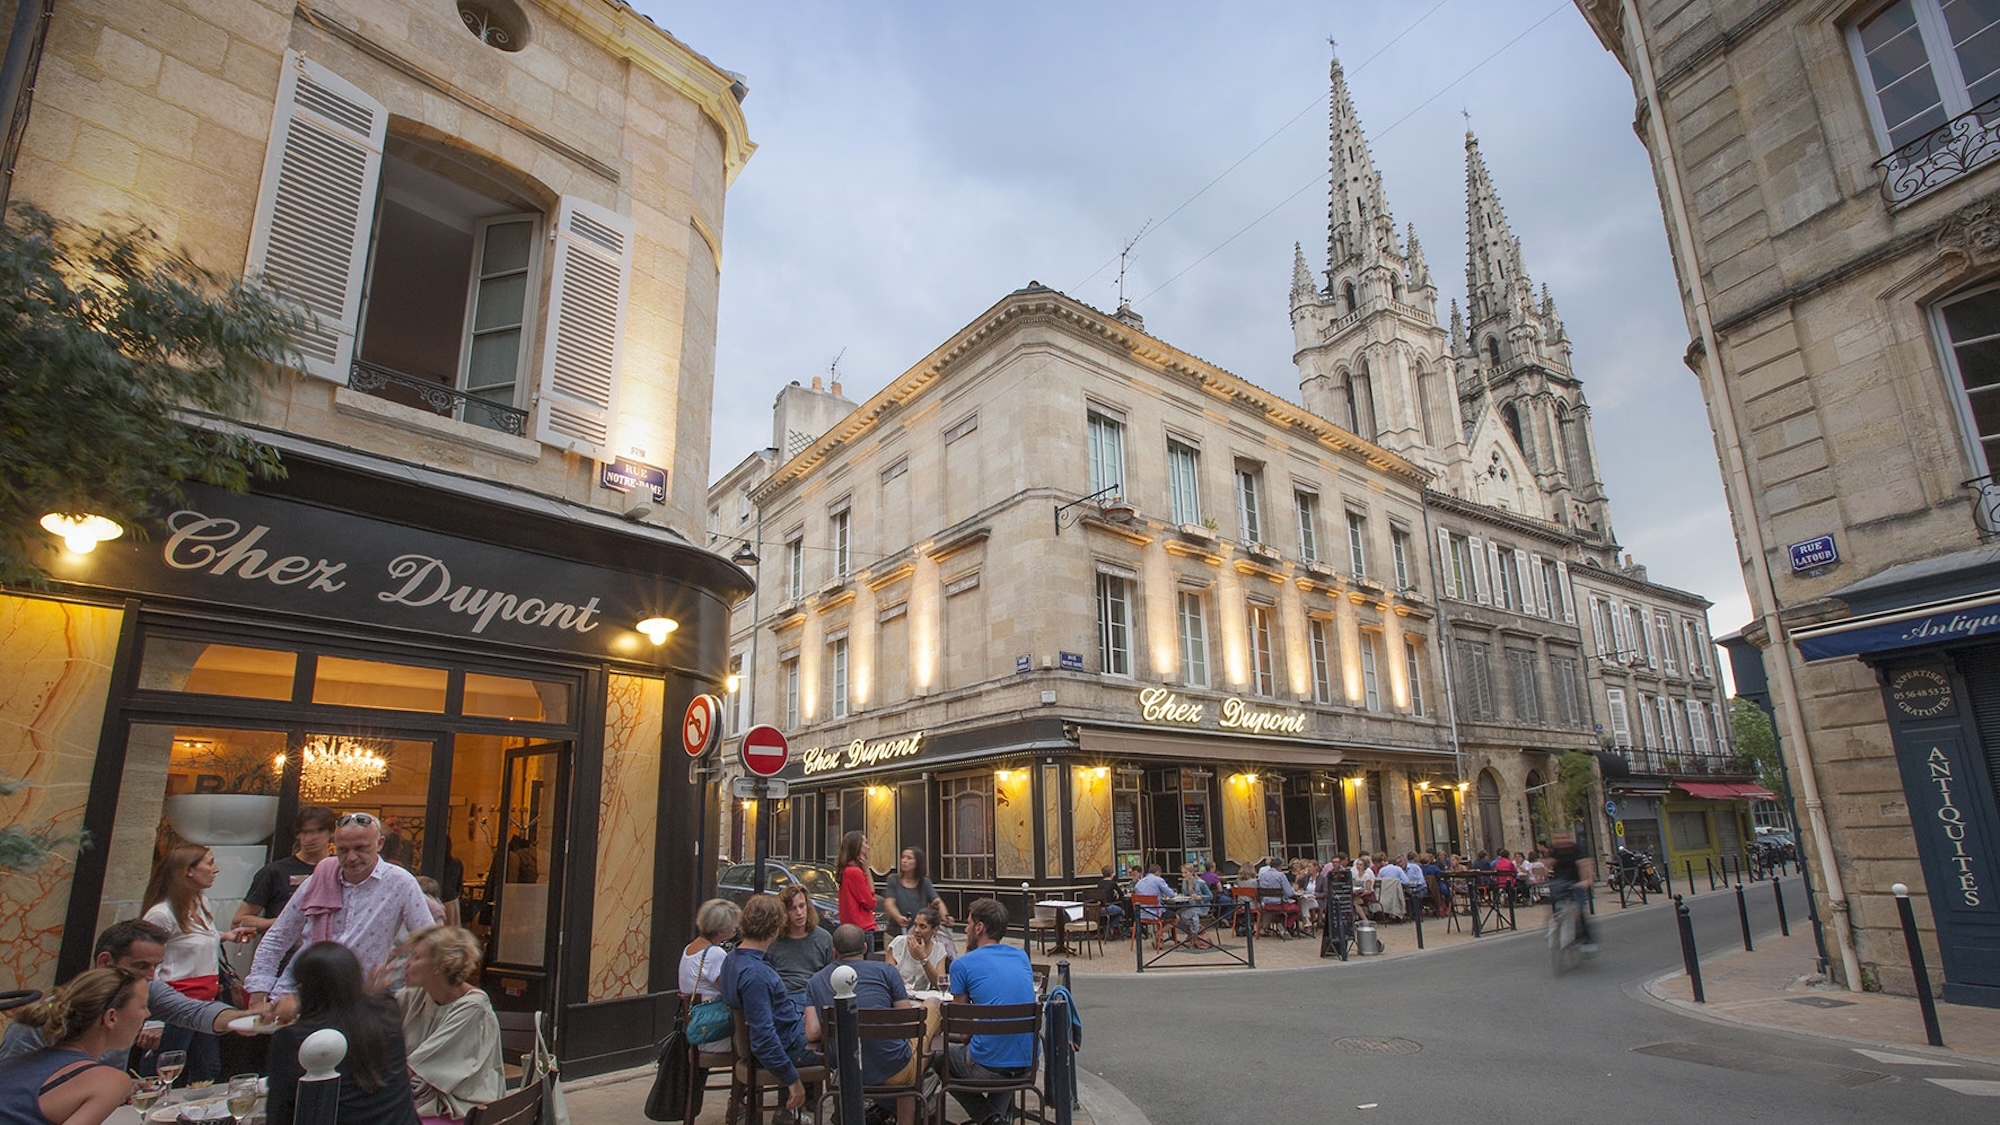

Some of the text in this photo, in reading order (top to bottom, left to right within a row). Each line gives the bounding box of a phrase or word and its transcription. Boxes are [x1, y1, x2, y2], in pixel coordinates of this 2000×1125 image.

[625, 464, 648, 478] RUE
[1800, 541, 1823, 555] RUE
[1795, 550, 1832, 566] LATOUR
[164, 509, 601, 633] Chez Dupont
[1902, 614, 2000, 640] Antiqu
[1893, 670, 1946, 689] EXPERTISES
[1894, 692, 1904, 700] 05
[1905, 690, 1916, 699] 56
[1139, 686, 1306, 733] Chez Dupont
[1898, 696, 1950, 716] GRATUITES
[803, 731, 922, 776] Chez Dupont
